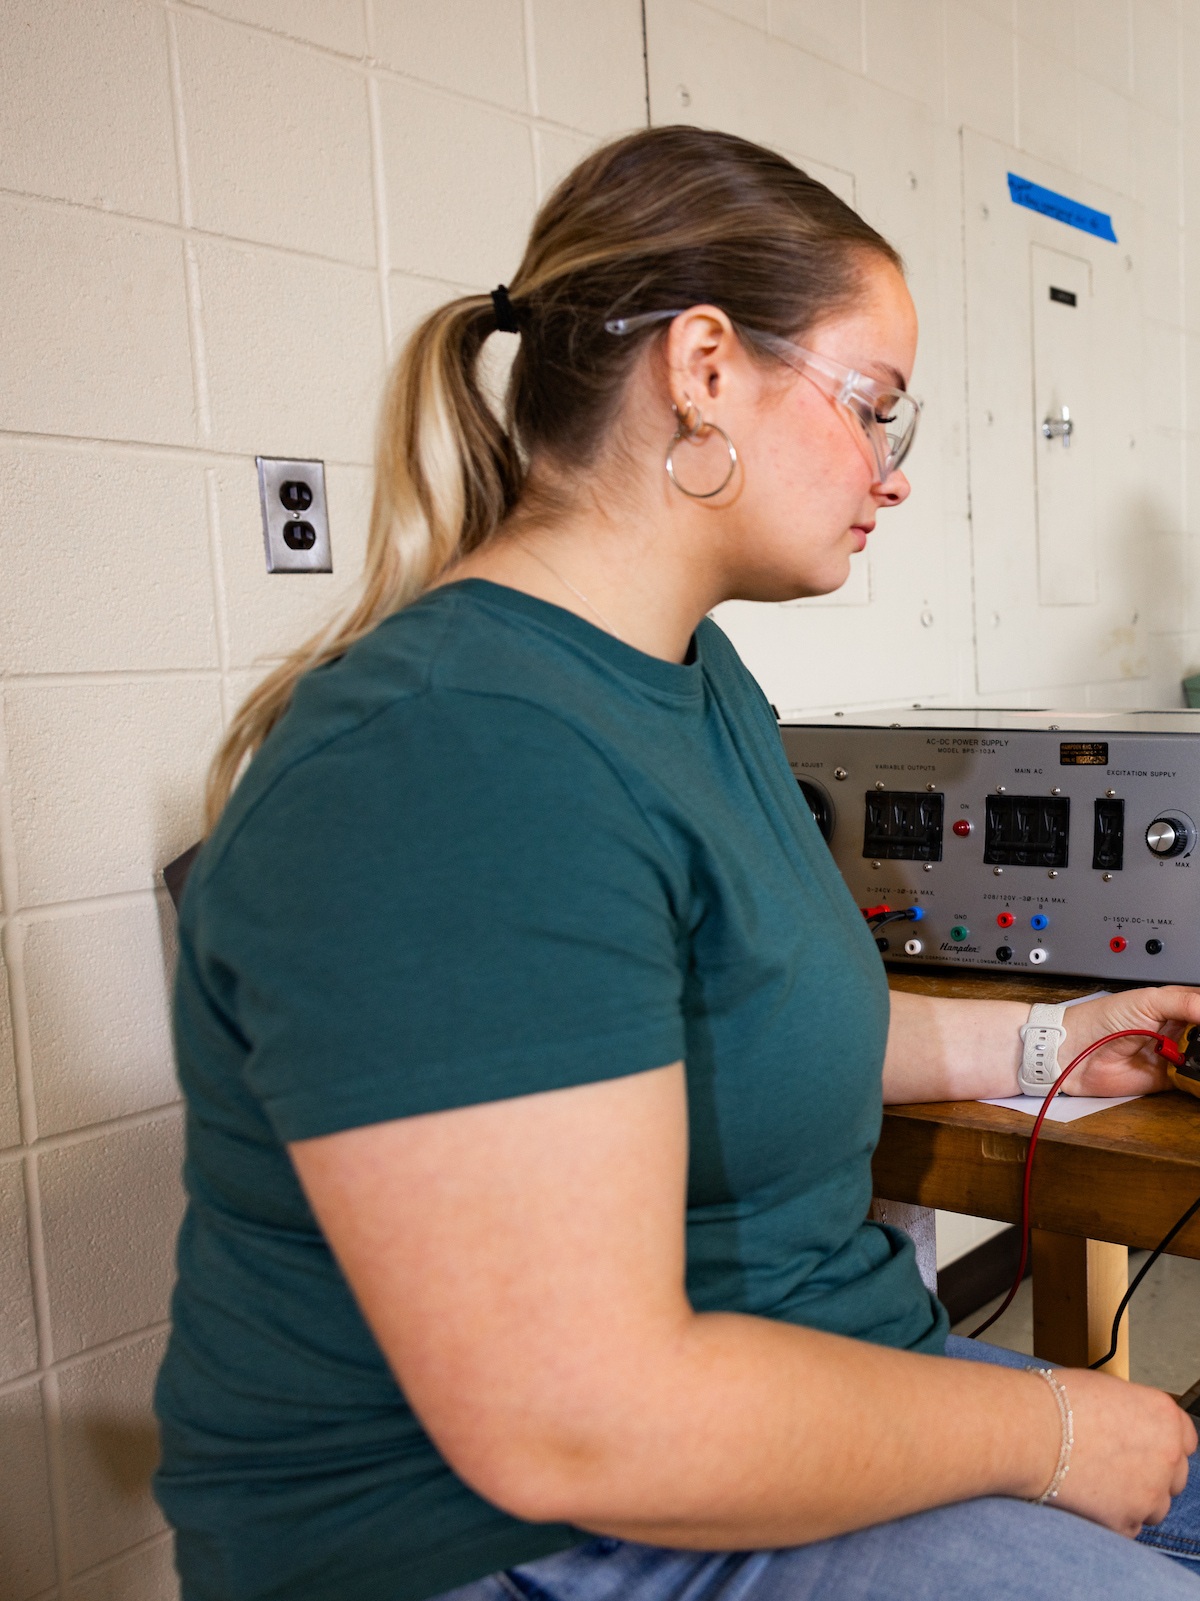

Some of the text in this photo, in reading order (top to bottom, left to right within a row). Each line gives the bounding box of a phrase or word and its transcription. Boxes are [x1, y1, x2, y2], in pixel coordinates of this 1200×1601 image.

[926, 738, 1009, 748] AC-DC POWER SUPPLY
[938, 747, 959, 755] MODEL
[906, 764, 936, 772] OUTPUTS
[939, 942, 978, 954] Hampden
